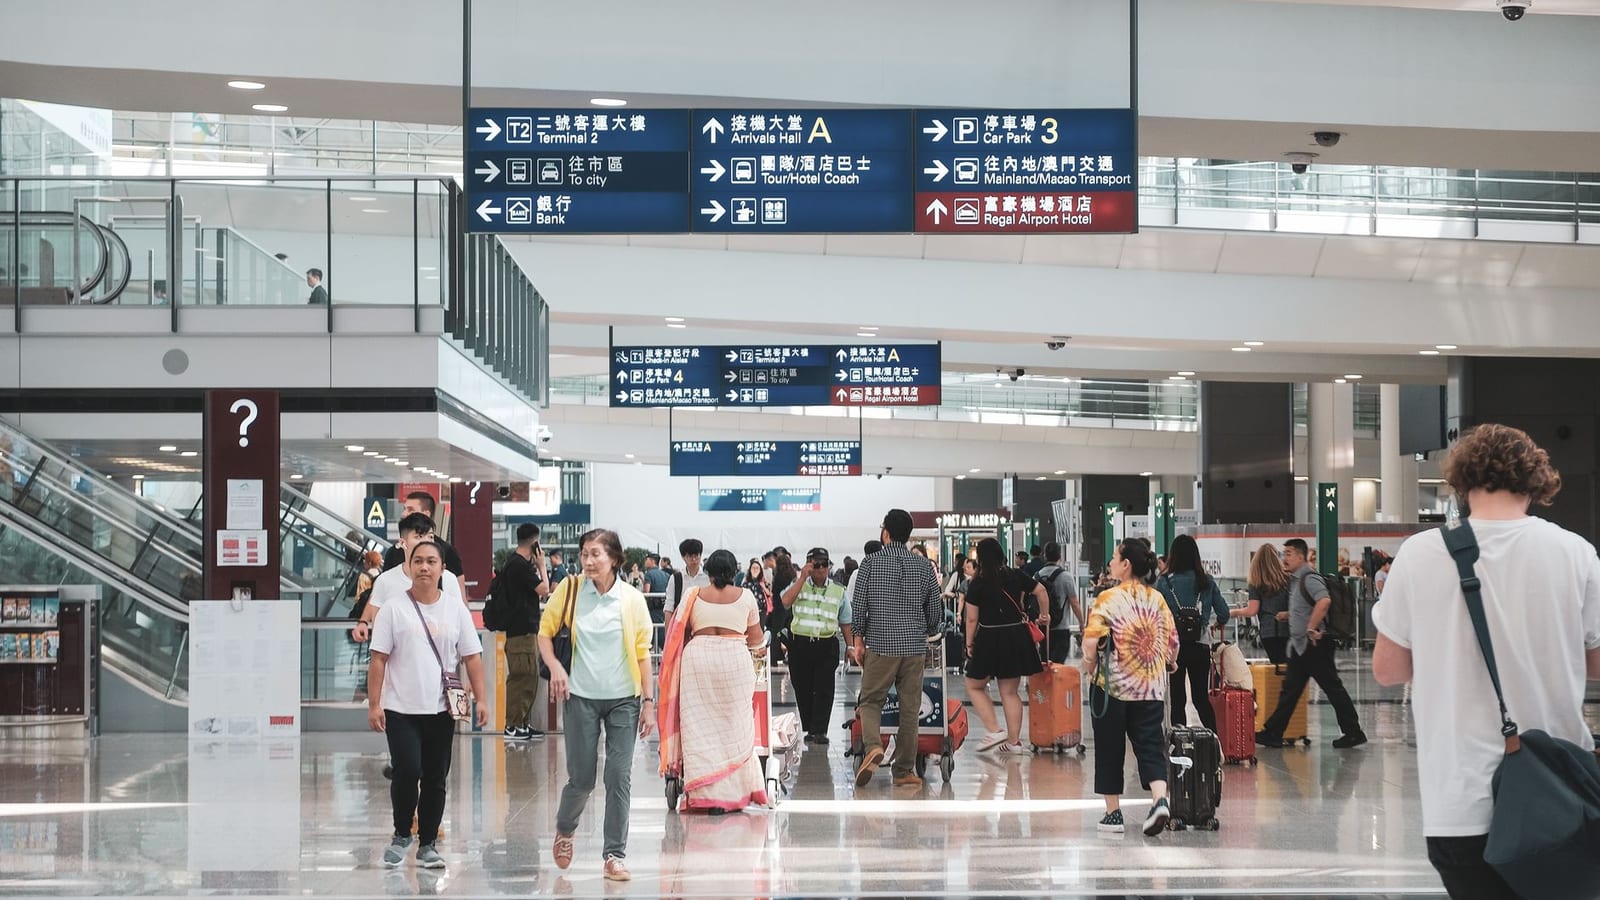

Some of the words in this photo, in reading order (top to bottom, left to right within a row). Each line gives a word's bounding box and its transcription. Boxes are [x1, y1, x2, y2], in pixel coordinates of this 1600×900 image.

[509, 122, 530, 138] T2
[536, 115, 646, 131] 二號客運大樓
[731, 115, 803, 131] 接機大堂
[984, 115, 1036, 131] 停車場
[807, 117, 833, 144] A
[958, 120, 975, 141] P
[1040, 117, 1059, 144] 3
[537, 132, 587, 144] Terminal
[591, 133, 598, 144] 2
[731, 132, 776, 144] Arrivals
[779, 132, 801, 144] Hall
[983, 132, 1004, 144] Car
[1006, 132, 1032, 144] Park
[568, 156, 623, 172] 往市區
[761, 155, 871, 172] 團隊/酒店巴士
[984, 155, 1114, 172] 往內地/澳門交通
[568, 173, 583, 185] To
[586, 173, 607, 187] city
[761, 172, 821, 184] Tour/Hotel
[824, 172, 860, 184] Coach
[984, 173, 1077, 185] Mainland/Macao
[1078, 173, 1131, 186] Transport
[537, 195, 572, 213] 銀行
[984, 195, 1092, 213] 富豪機場酒店
[536, 213, 565, 225] Bank
[984, 213, 1016, 227] Regal
[1019, 213, 1059, 226] Airport
[1063, 213, 1092, 225] Hotel
[632, 353, 642, 361] T1
[741, 351, 752, 361] T2
[887, 348, 900, 362] A
[633, 372, 642, 382] P
[673, 369, 684, 384] 4
[865, 395, 881, 403] Regal
[882, 395, 902, 403] Airport
[704, 442, 711, 452] A
[367, 500, 385, 520] A
